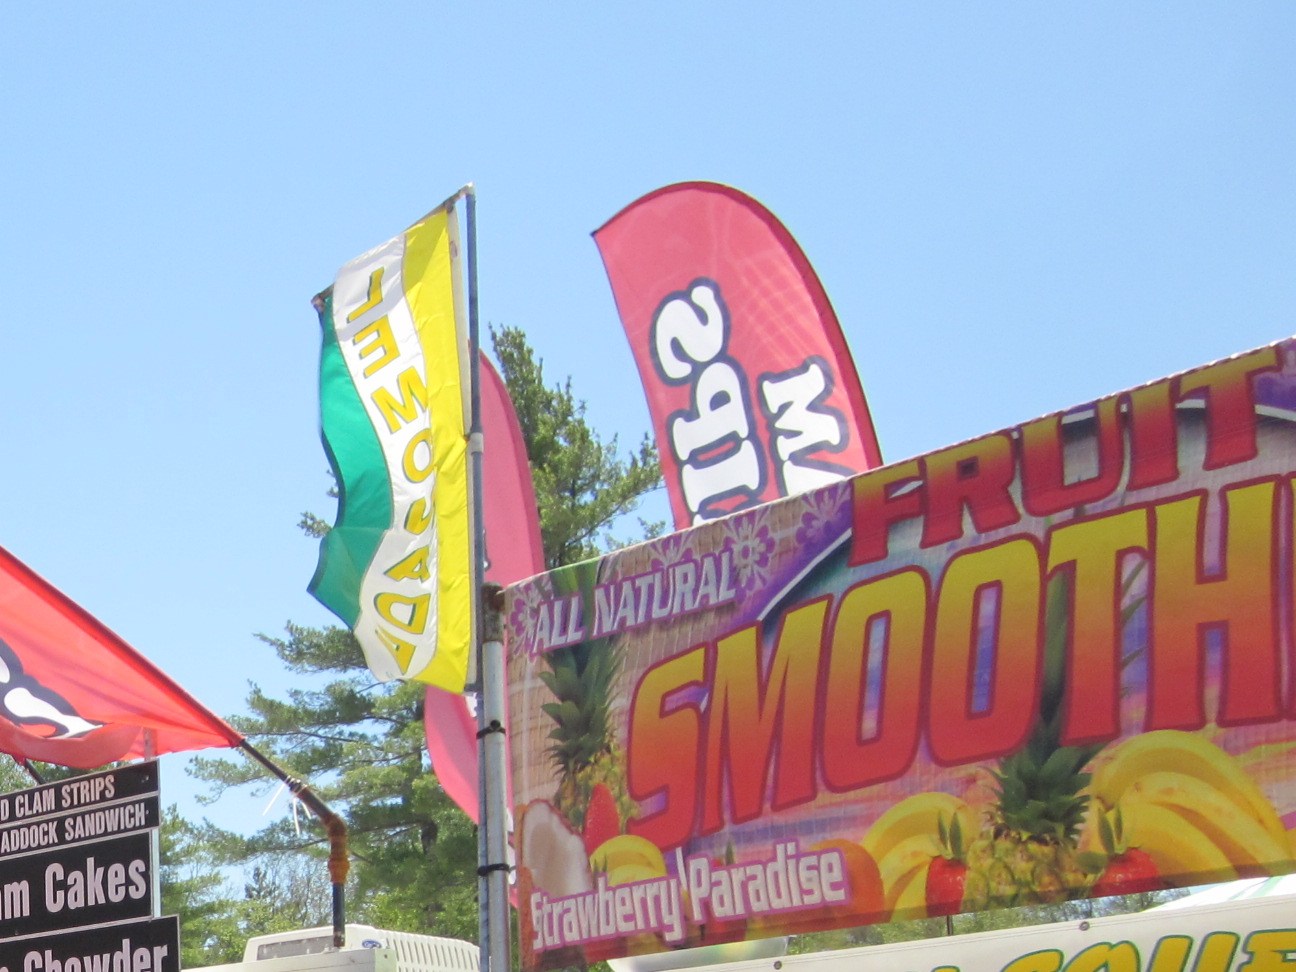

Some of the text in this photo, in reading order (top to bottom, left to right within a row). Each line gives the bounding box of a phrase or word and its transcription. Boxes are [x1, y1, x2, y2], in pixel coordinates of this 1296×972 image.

[847, 345, 1284, 567] FRUIT
[532, 551, 736, 655] ALL NATURAL
[625, 474, 1296, 854] SMOOTH
[15, 788, 54, 817] CLAM
[61, 774, 115, 807] STRIPS
[64, 802, 145, 841] SANDWICH
[44, 856, 147, 913] Cakes
[531, 842, 847, 951] Strawberry Paradise
